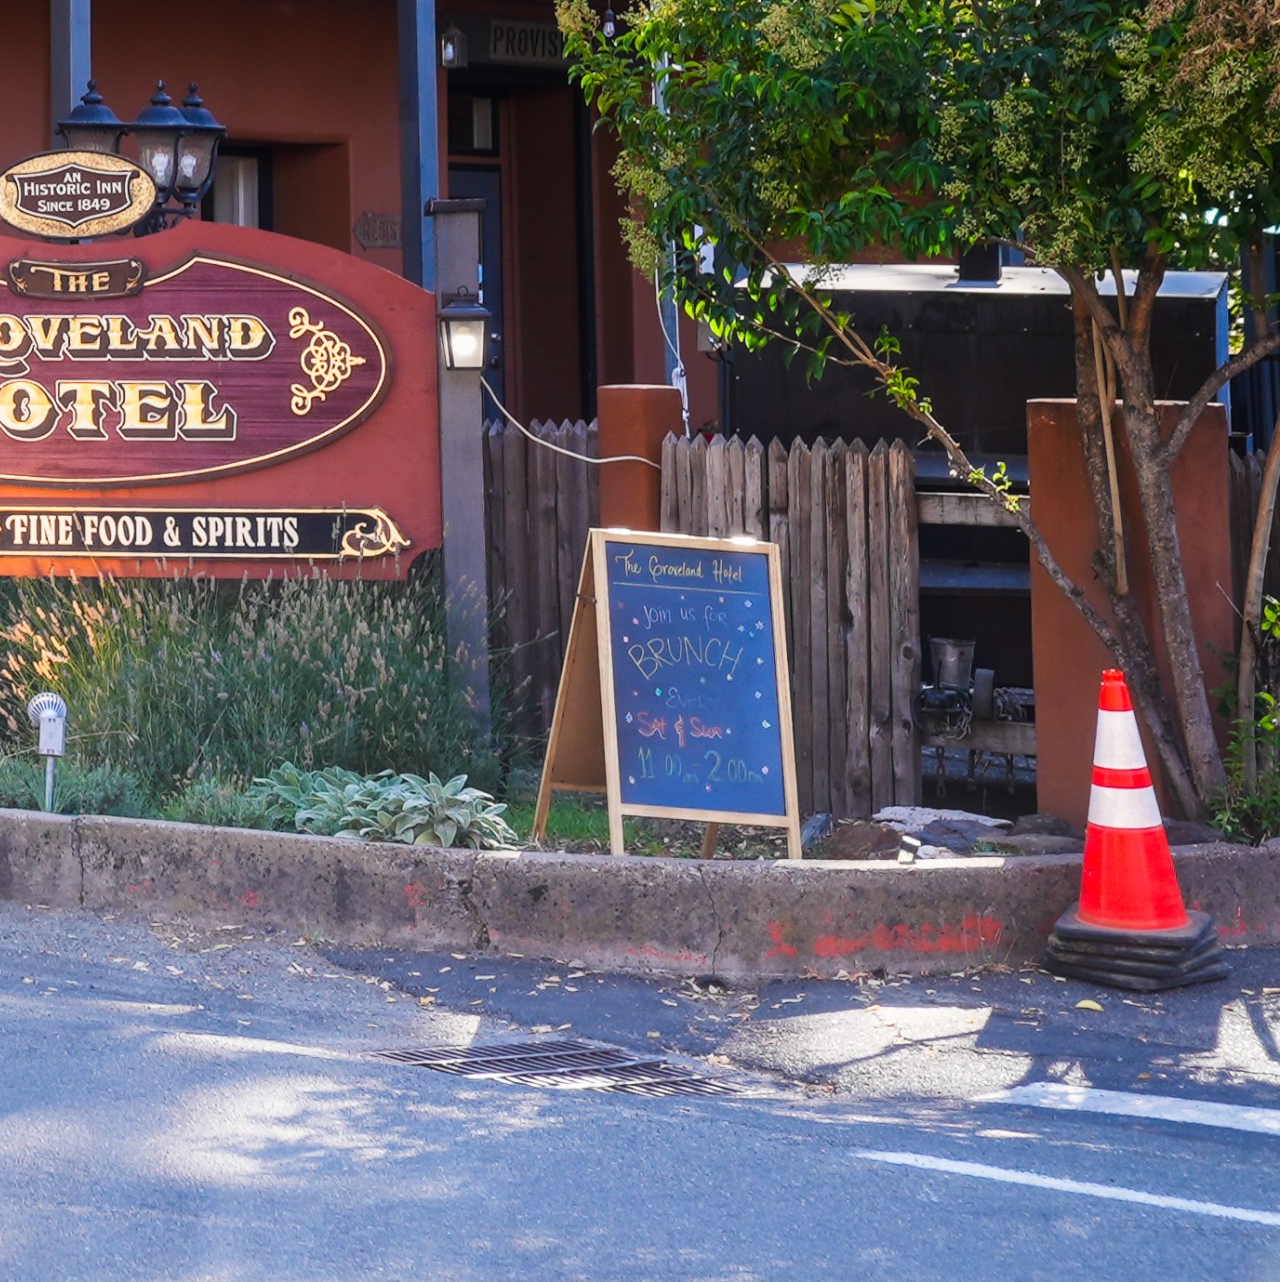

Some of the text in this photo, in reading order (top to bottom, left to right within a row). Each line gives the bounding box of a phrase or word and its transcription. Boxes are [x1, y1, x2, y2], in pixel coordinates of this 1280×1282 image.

[63, 172, 81, 183] AN
[78, 198, 111, 211] 1849
[30, 267, 110, 292] THE
[5, 514, 73, 545] FINE
[83, 515, 153, 546] FOOD
[163, 516, 182, 547] &
[192, 516, 300, 547] SPIRITS
[615, 549, 742, 584] The Groveland Hotel
[680, 607, 696, 620] us
[628, 636, 743, 680] BRUNCH
